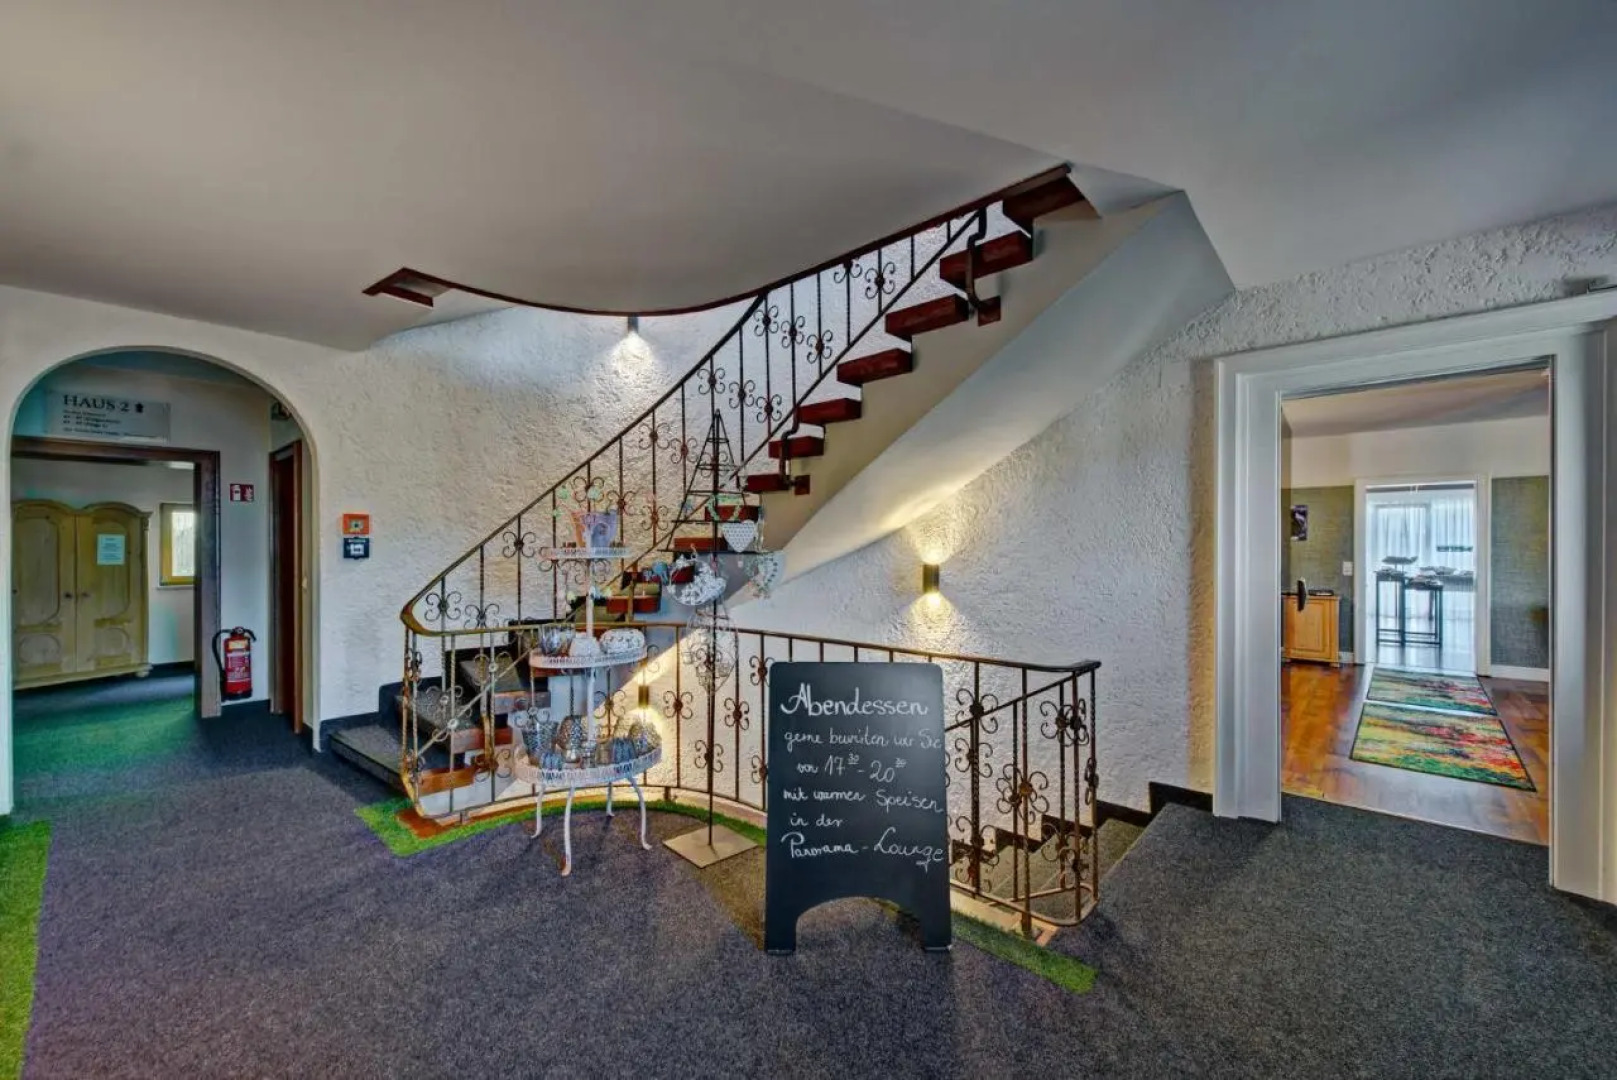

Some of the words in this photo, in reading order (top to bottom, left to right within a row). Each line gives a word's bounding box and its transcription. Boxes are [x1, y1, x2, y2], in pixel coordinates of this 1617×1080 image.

[63, 394, 116, 411] HAUS
[119, 402, 130, 413] 2
[780, 682, 929, 716] Abendessen
[784, 730, 824, 752] gerne
[783, 787, 808, 801] mit
[813, 789, 867, 801] warmen
[876, 789, 943, 813] Speisen
[790, 812, 808, 827] in
[815, 814, 843, 827] der
[780, 831, 859, 859] Panorama
